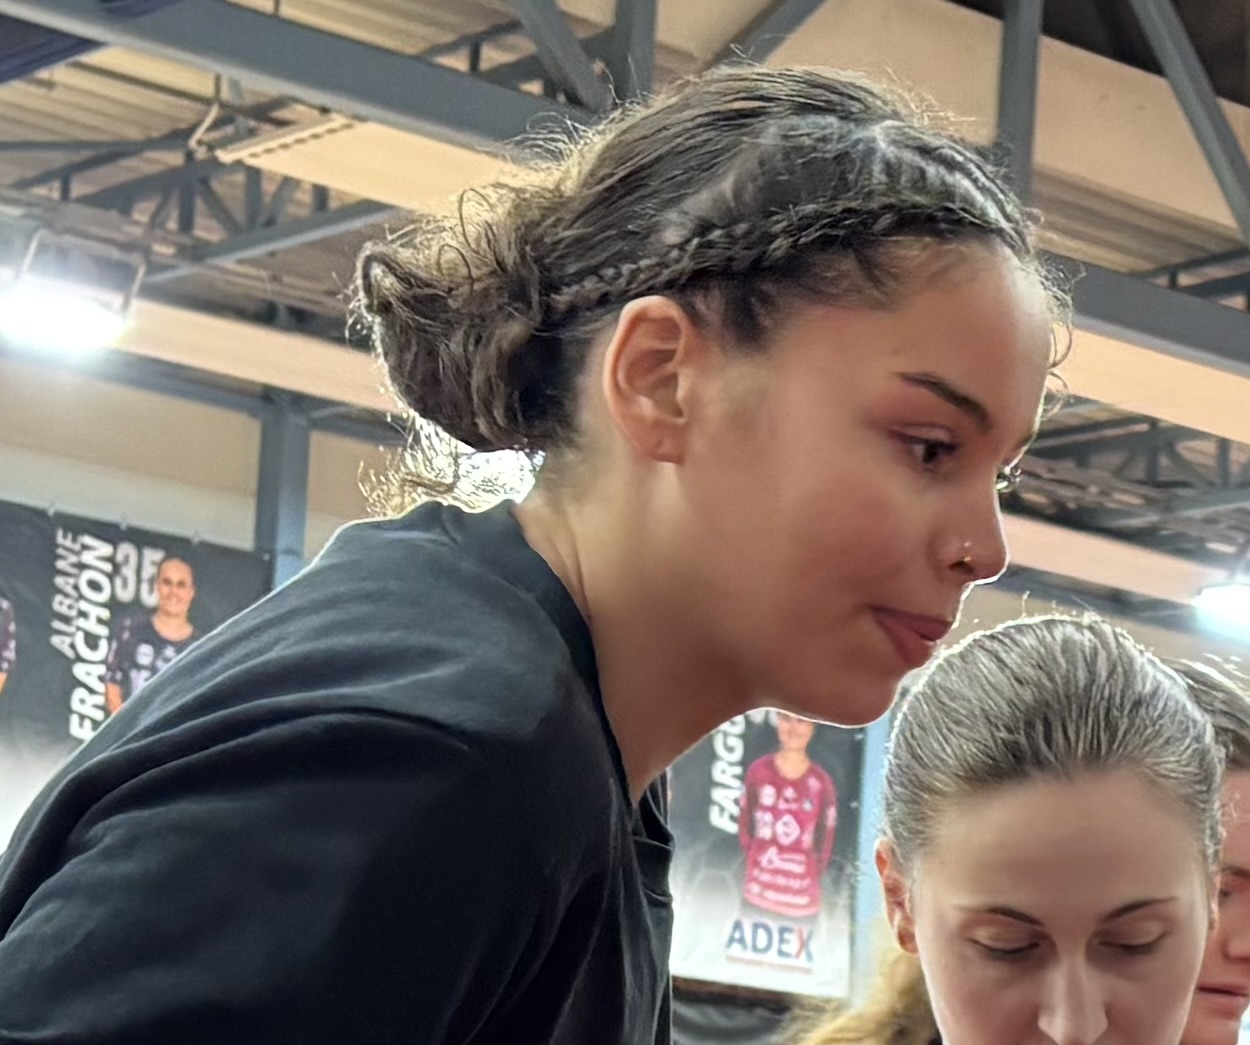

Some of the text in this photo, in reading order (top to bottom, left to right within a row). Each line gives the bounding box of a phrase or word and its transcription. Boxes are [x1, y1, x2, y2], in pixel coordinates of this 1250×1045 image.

[49, 527, 83, 660] ALBANE
[68, 534, 115, 741] FRACHON
[725, 918, 815, 963] ADEX
